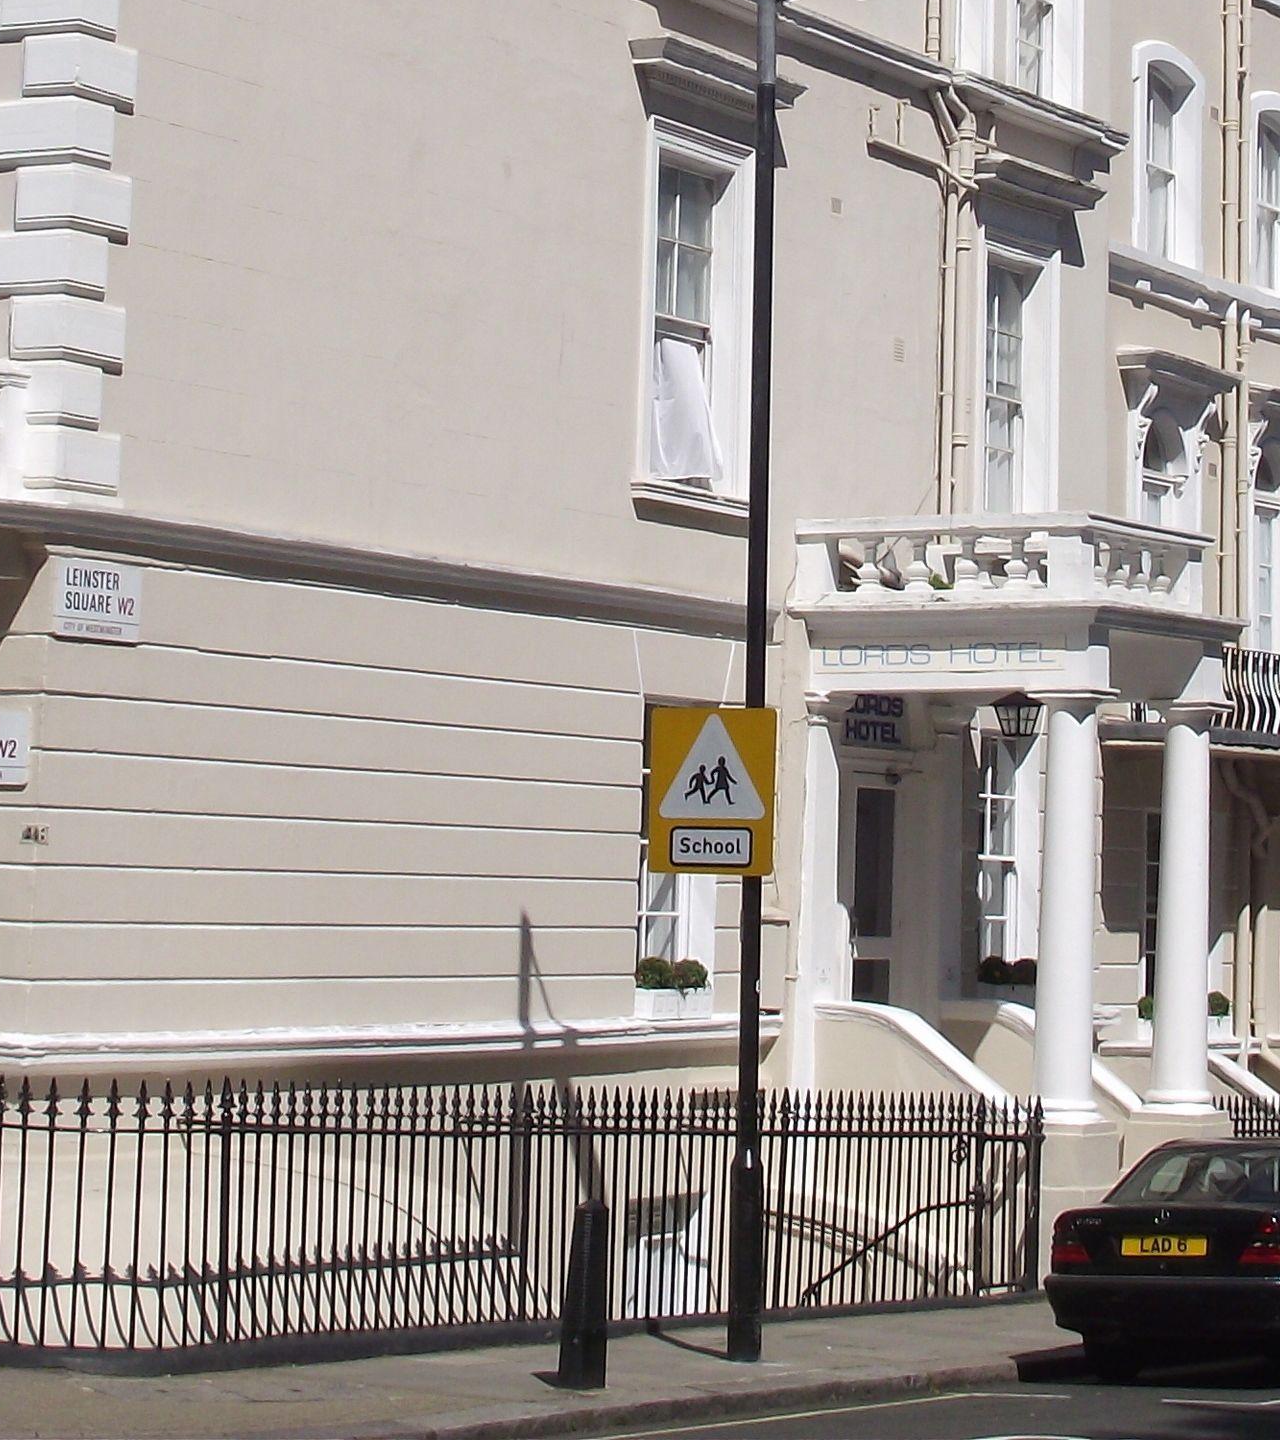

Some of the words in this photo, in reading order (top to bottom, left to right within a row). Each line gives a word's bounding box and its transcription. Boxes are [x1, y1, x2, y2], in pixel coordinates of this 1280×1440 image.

[65, 566, 120, 591] LEINSTER
[64, 590, 112, 614] SQUARE
[117, 597, 135, 616] W2
[822, 644, 931, 667] LORDS
[949, 642, 1056, 665] HOTEL
[845, 718, 901, 744] HOTEL
[679, 836, 741, 855] School
[1140, 1237, 1171, 1253] LAD
[1177, 1239, 1188, 1253] 6
